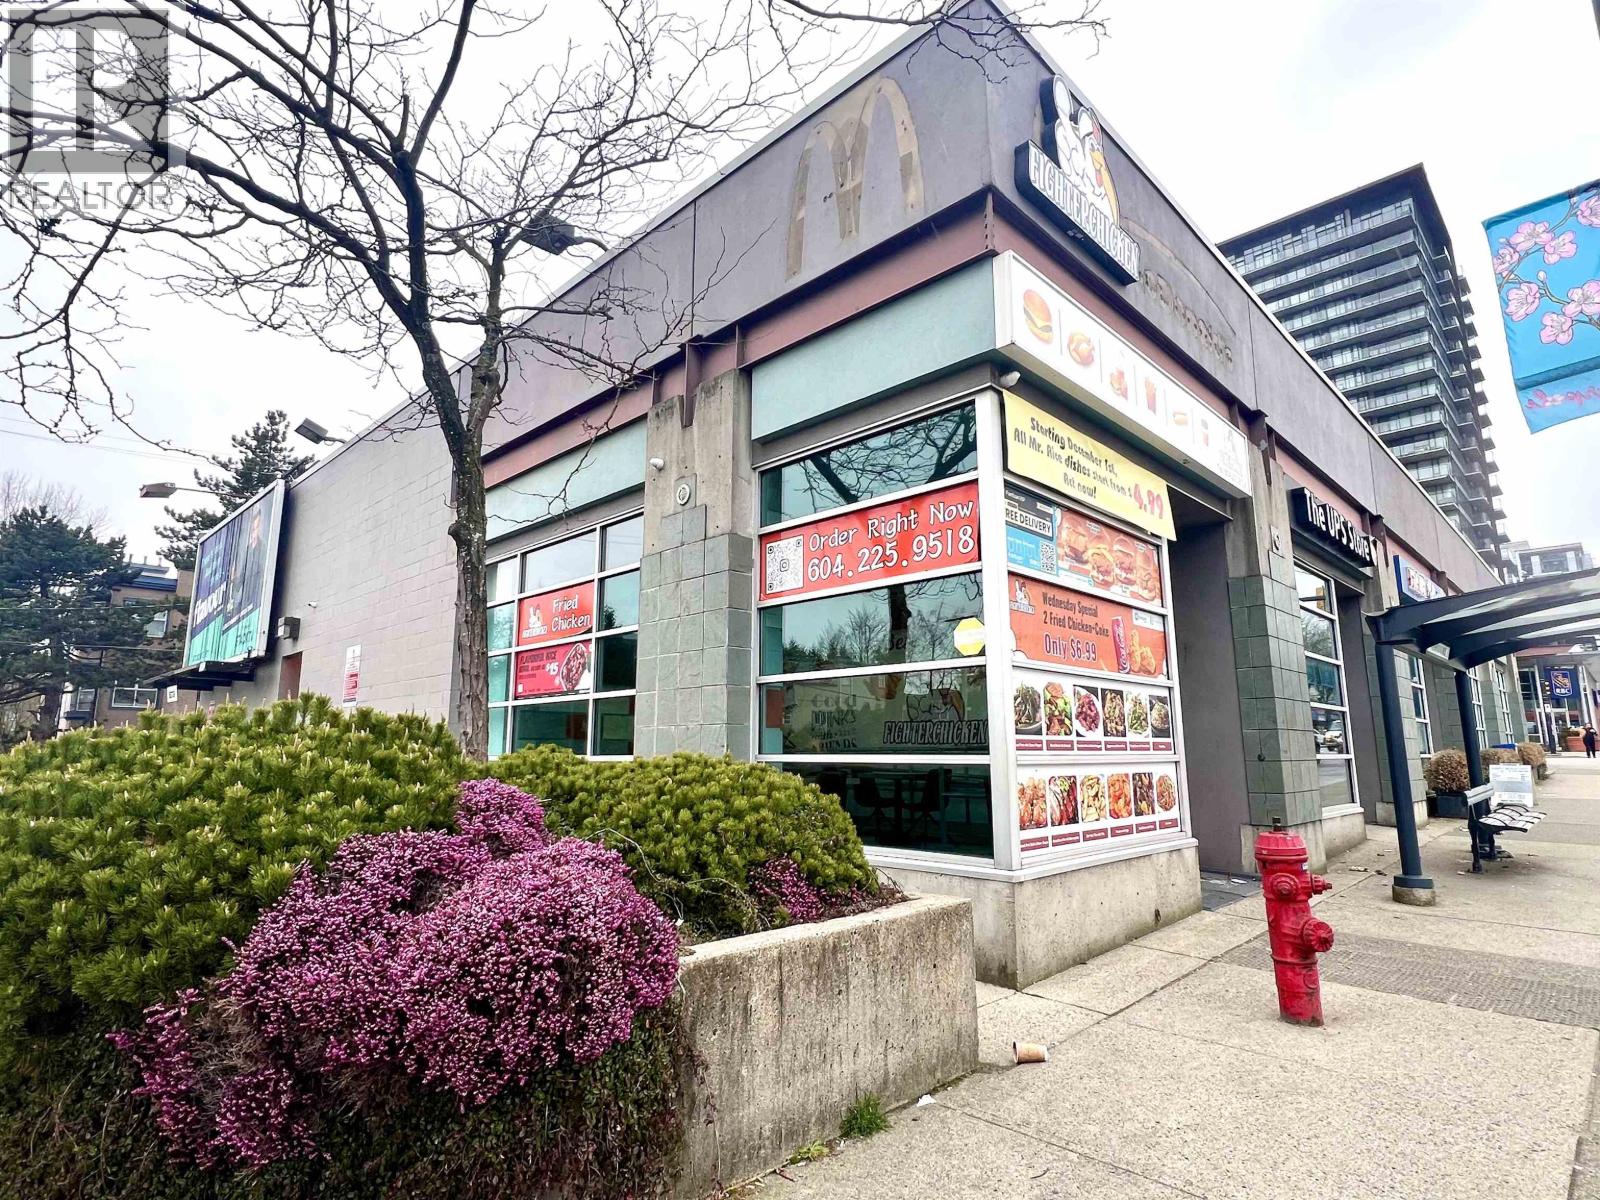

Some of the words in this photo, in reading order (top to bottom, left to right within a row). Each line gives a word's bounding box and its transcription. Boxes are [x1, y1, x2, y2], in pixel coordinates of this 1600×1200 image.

[1030, 146, 1139, 279] FIGHTERCHICKEN
[1030, 416, 1066, 450] Starting
[1066, 436, 1102, 468] December
[1013, 427, 1027, 446] All
[1029, 434, 1044, 454] Mr.
[1046, 444, 1063, 464] Rice
[1064, 455, 1091, 478] dishes
[1092, 470, 1109, 488] start
[1109, 478, 1127, 497] from
[1077, 482, 1097, 499] now!
[808, 526, 859, 552] Order
[867, 509, 919, 541] Right
[929, 500, 975, 526] Now
[1005, 508, 1019, 522] REE
[1019, 512, 1051, 534] DELIVERY
[1303, 487, 1327, 531] The
[1326, 503, 1348, 545] UPS
[1347, 520, 1370, 562] Store
[806, 525, 976, 584] 604.225.9518
[552, 594, 579, 613] Fried
[1042, 591, 1077, 615] Wednesday
[1077, 600, 1098, 618] Special
[551, 613, 591, 632] Chicken
[1043, 610, 1048, 625] 2
[1049, 611, 1066, 629] Fried
[1044, 633, 1068, 660] Only
[1070, 637, 1097, 662] $6.99
[883, 718, 988, 745] FIGHTERCHICKEN
